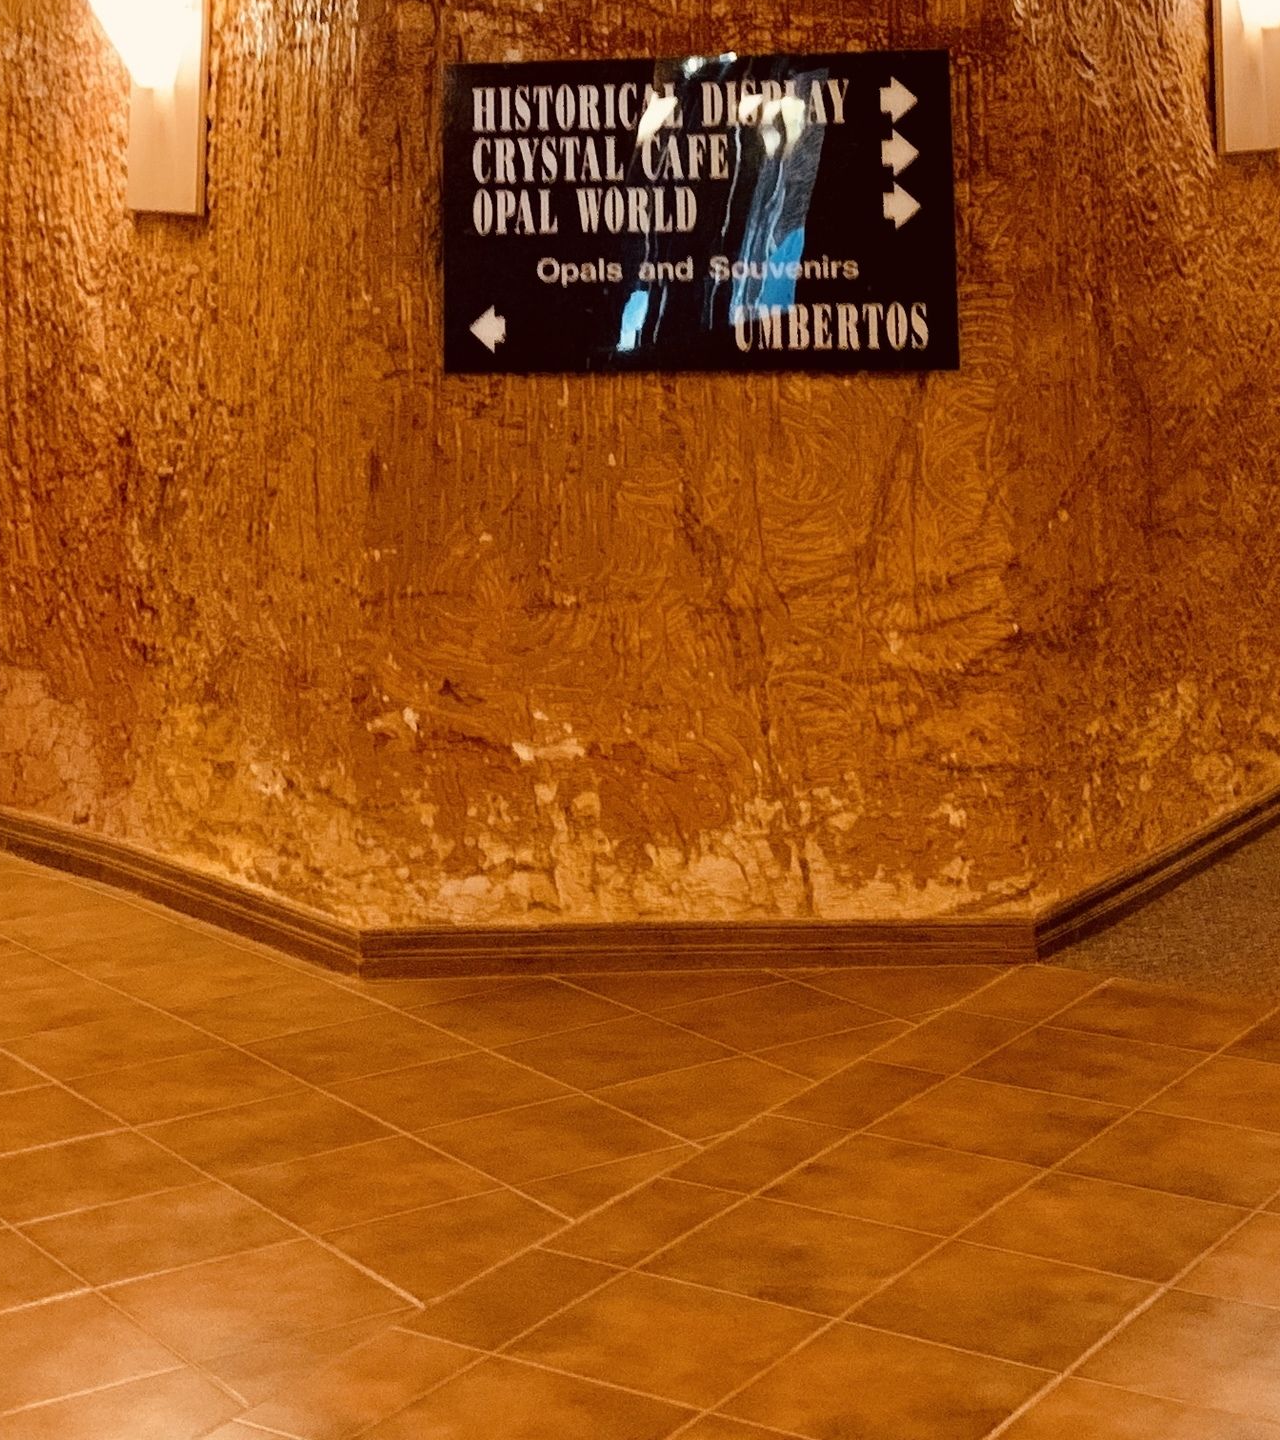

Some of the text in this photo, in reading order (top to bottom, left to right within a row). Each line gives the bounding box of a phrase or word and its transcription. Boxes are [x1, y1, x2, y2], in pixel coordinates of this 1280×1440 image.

[472, 133, 729, 184] CRYSTAL CAFE
[472, 186, 697, 236] OPAL WORLD
[536, 254, 859, 288] Opals and Souvenirs
[735, 301, 929, 352] UMBERTOS
